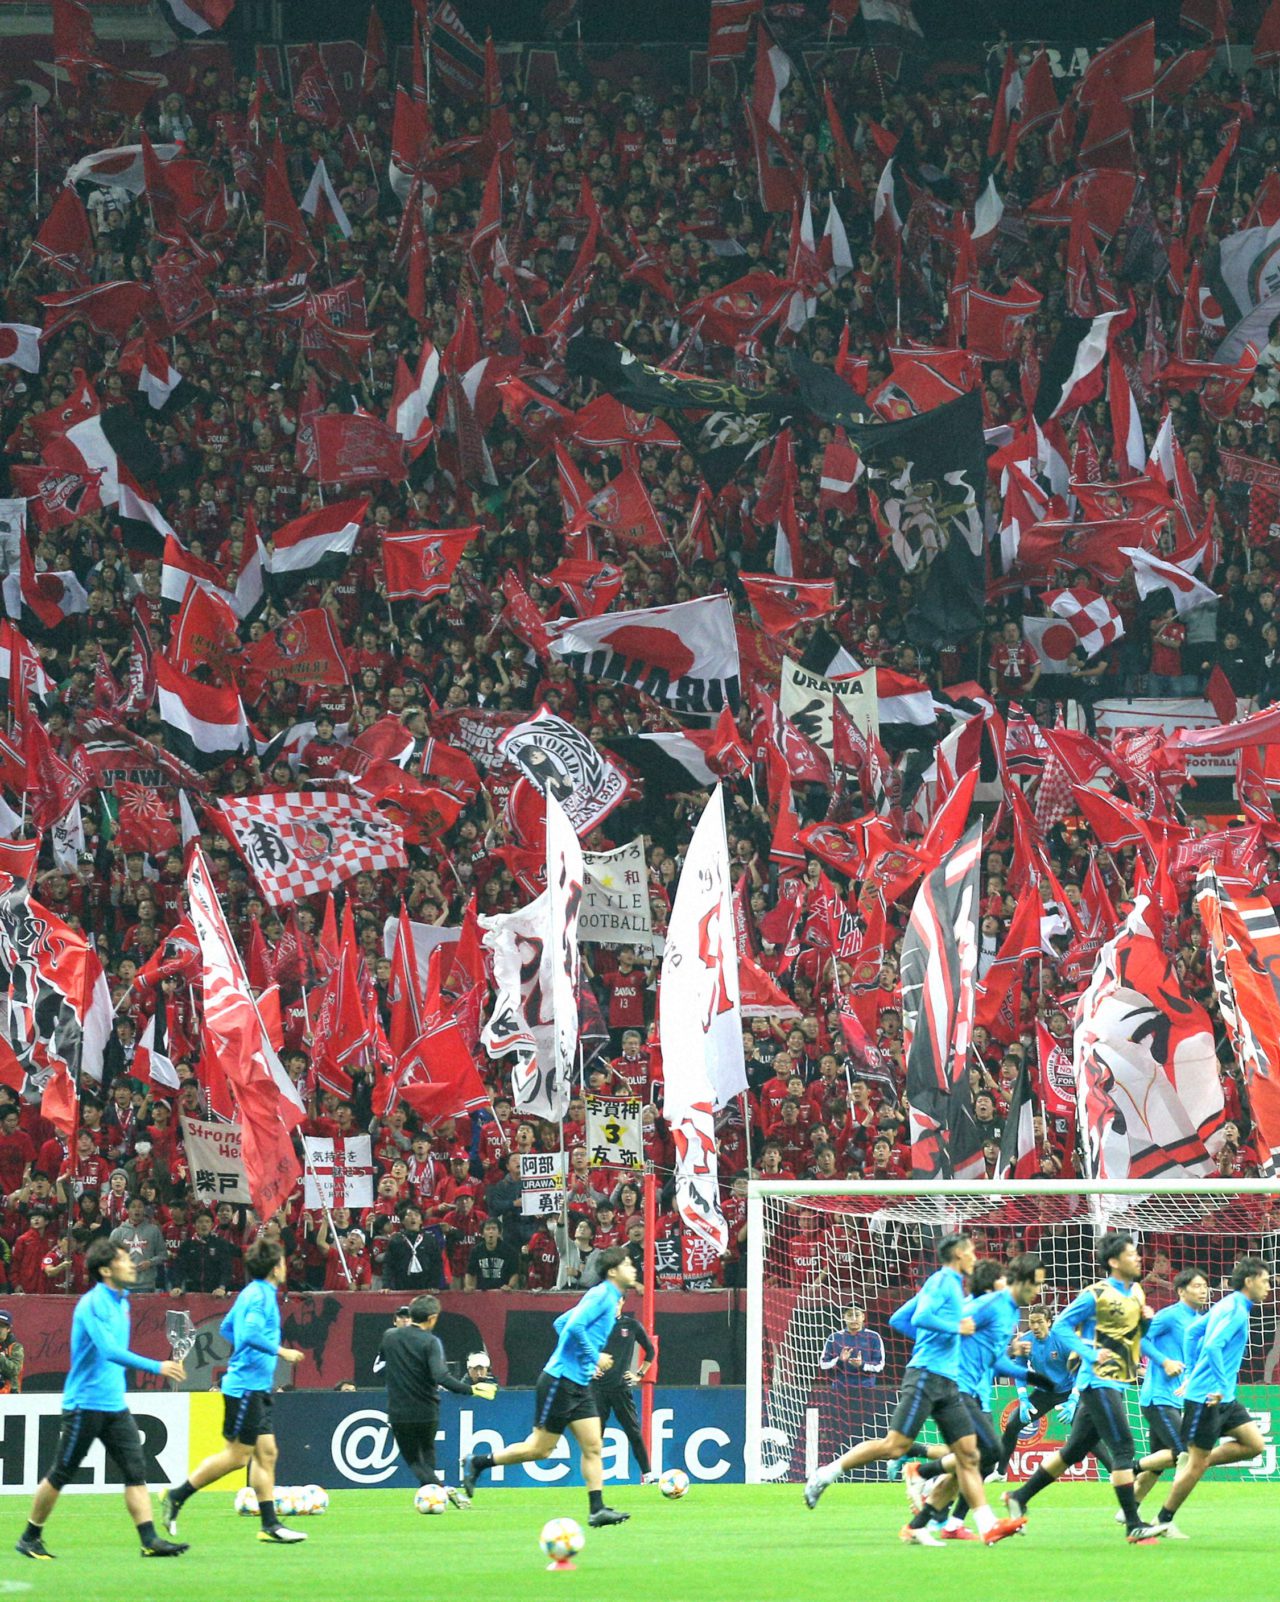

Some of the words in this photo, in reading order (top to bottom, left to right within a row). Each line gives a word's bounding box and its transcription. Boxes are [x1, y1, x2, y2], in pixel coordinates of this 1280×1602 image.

[792, 670, 864, 695] URAWA
[532, 734, 580, 776] WORLD
[1186, 758, 1238, 768] FOOTBALL
[588, 893, 642, 909] TYLE
[579, 914, 650, 932] OOTBALL
[587, 1101, 640, 1121] 宇賀神
[605, 1123, 620, 1144] 3
[522, 1156, 555, 1176] 阿部
[196, 1170, 239, 1194] 柴戸
[523, 1178, 555, 1189] URAWA
